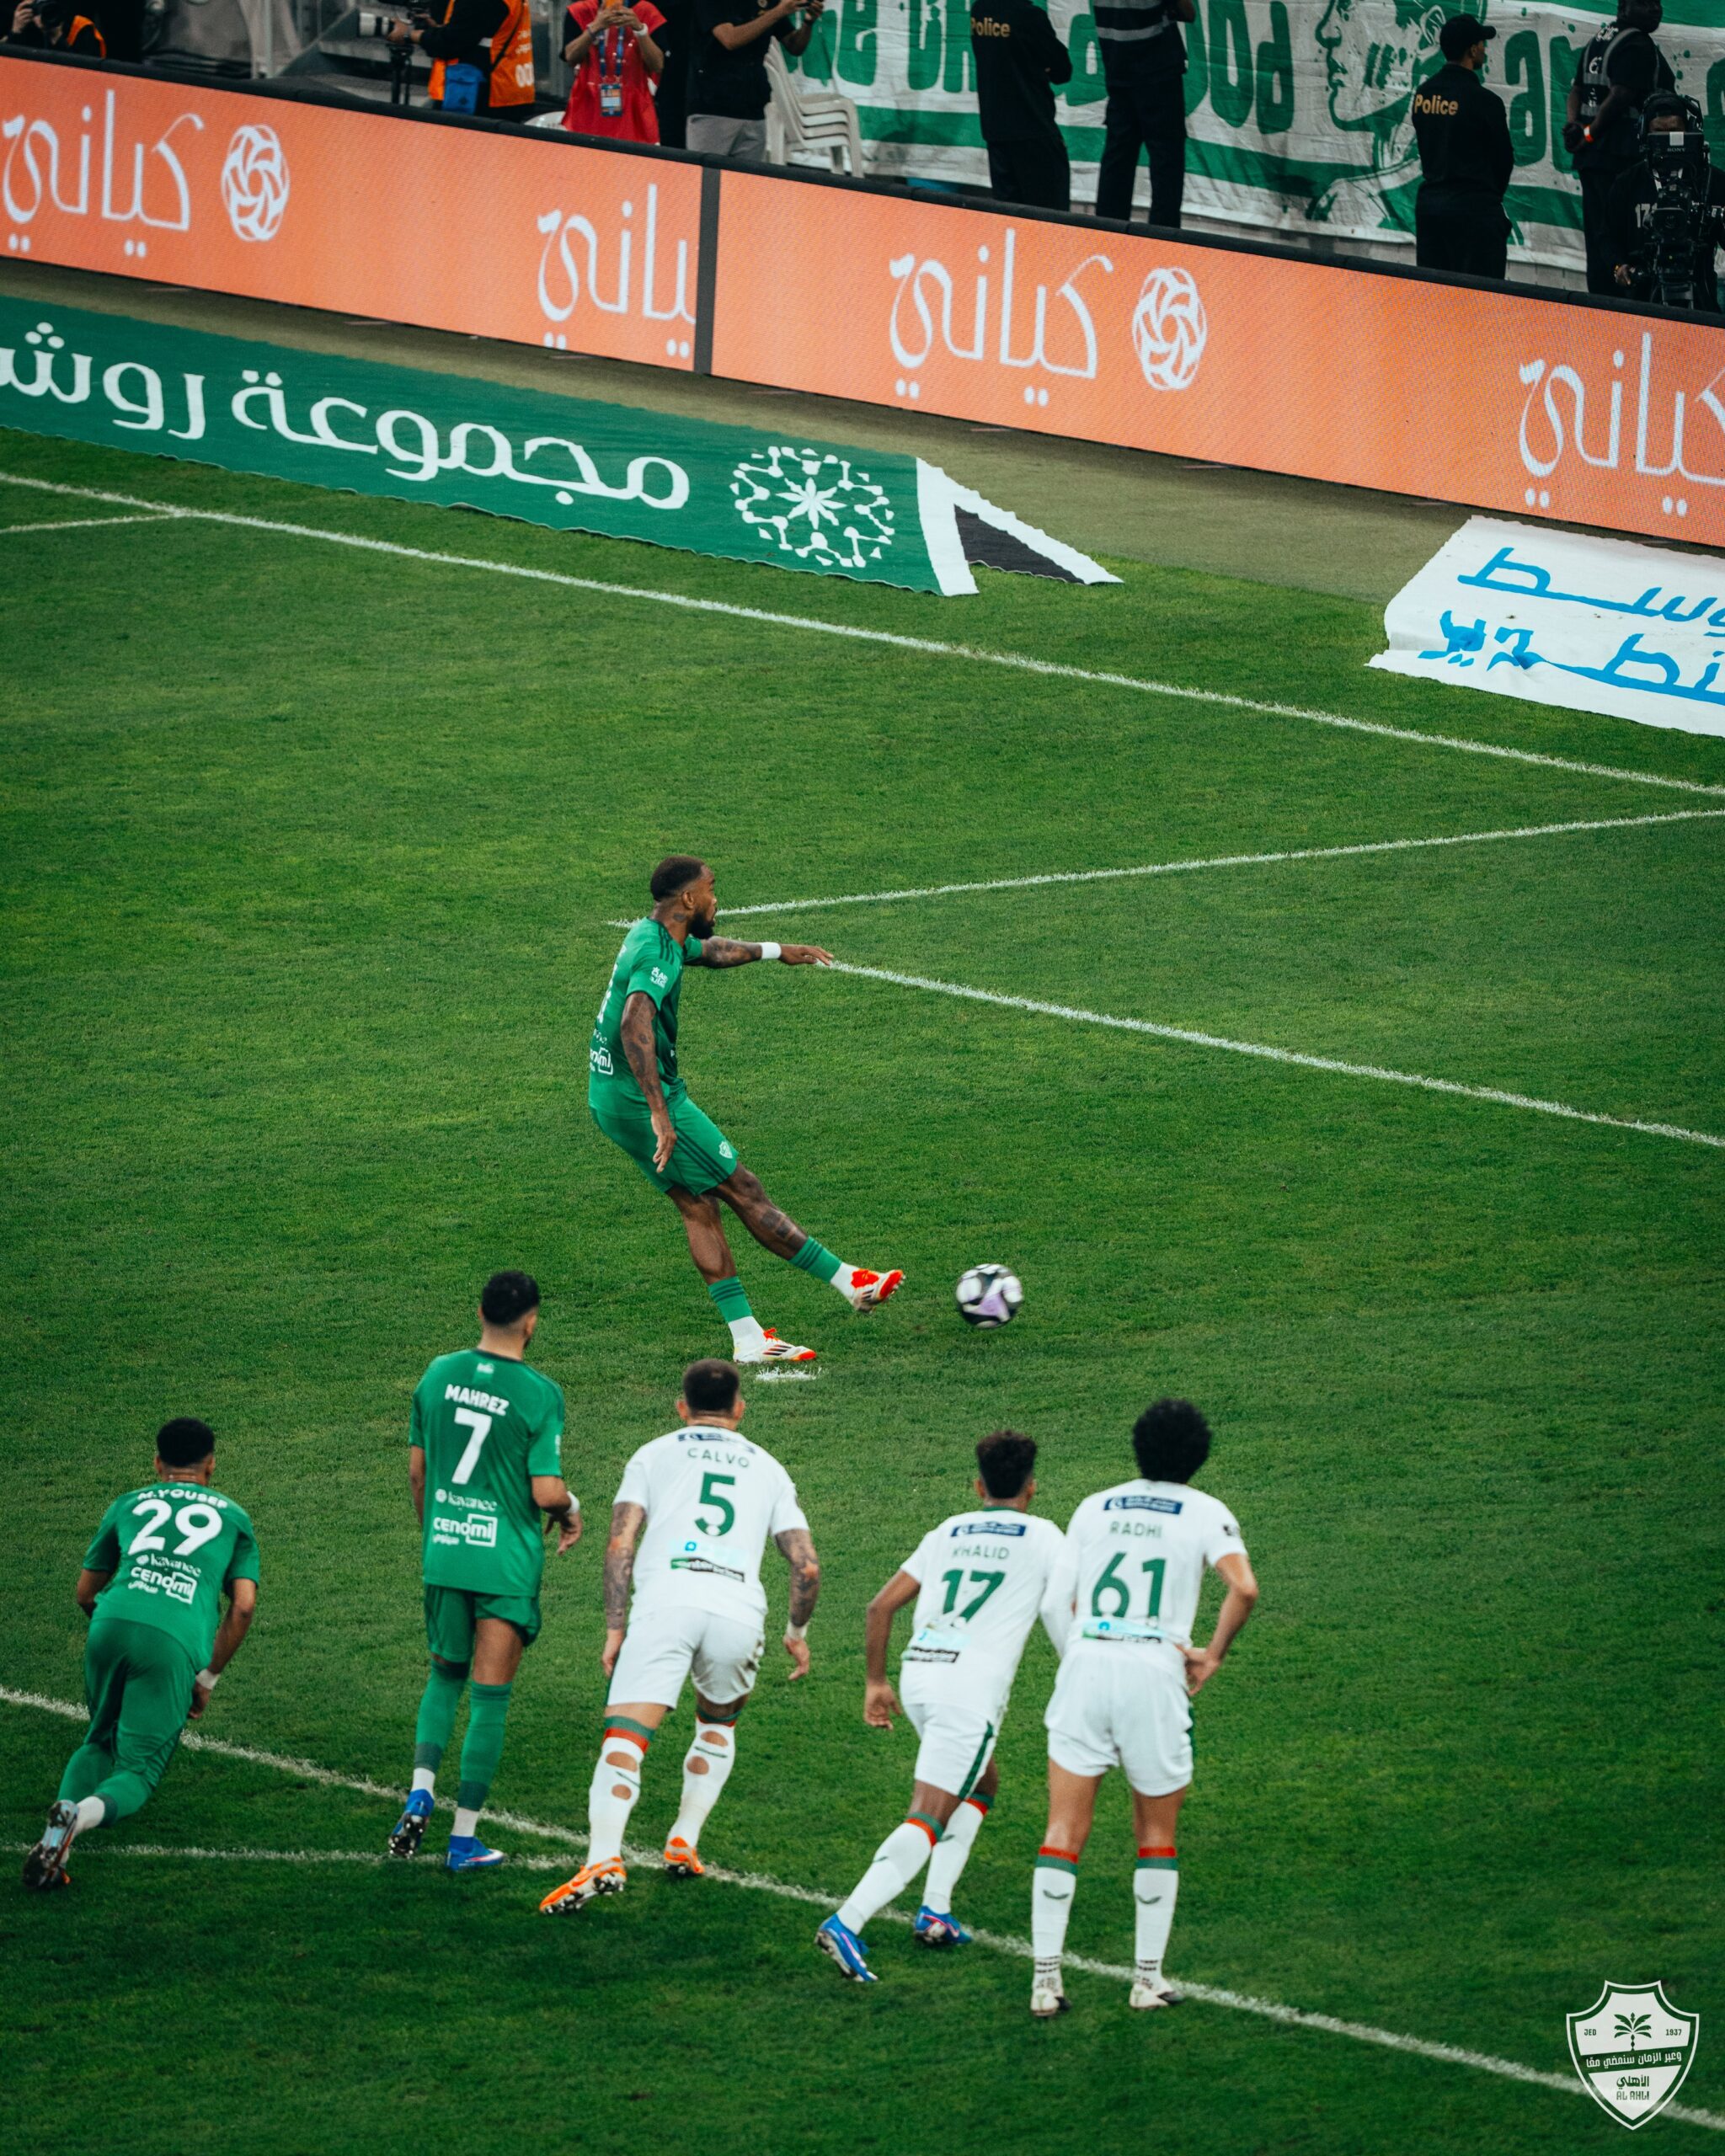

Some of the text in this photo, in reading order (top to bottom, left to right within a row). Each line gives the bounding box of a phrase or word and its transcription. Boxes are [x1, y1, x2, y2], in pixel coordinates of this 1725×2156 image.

[970, 17, 1011, 38] Police
[1414, 93, 1459, 116] Police
[3, 88, 205, 259] كياني
[537, 183, 697, 360] ياني
[889, 227, 1114, 408] كياني
[0, 322, 690, 510] مجموعة روش
[445, 1384, 510, 1416] MAHREZ
[451, 1406, 492, 1485] 7
[687, 1448, 750, 1468] CALVO
[128, 1498, 222, 1556] 29
[694, 1470, 735, 1537] 5
[1108, 1520, 1162, 1539] RADHI
[942, 1568, 1006, 1625] 17
[1092, 1551, 1166, 1622] 61
